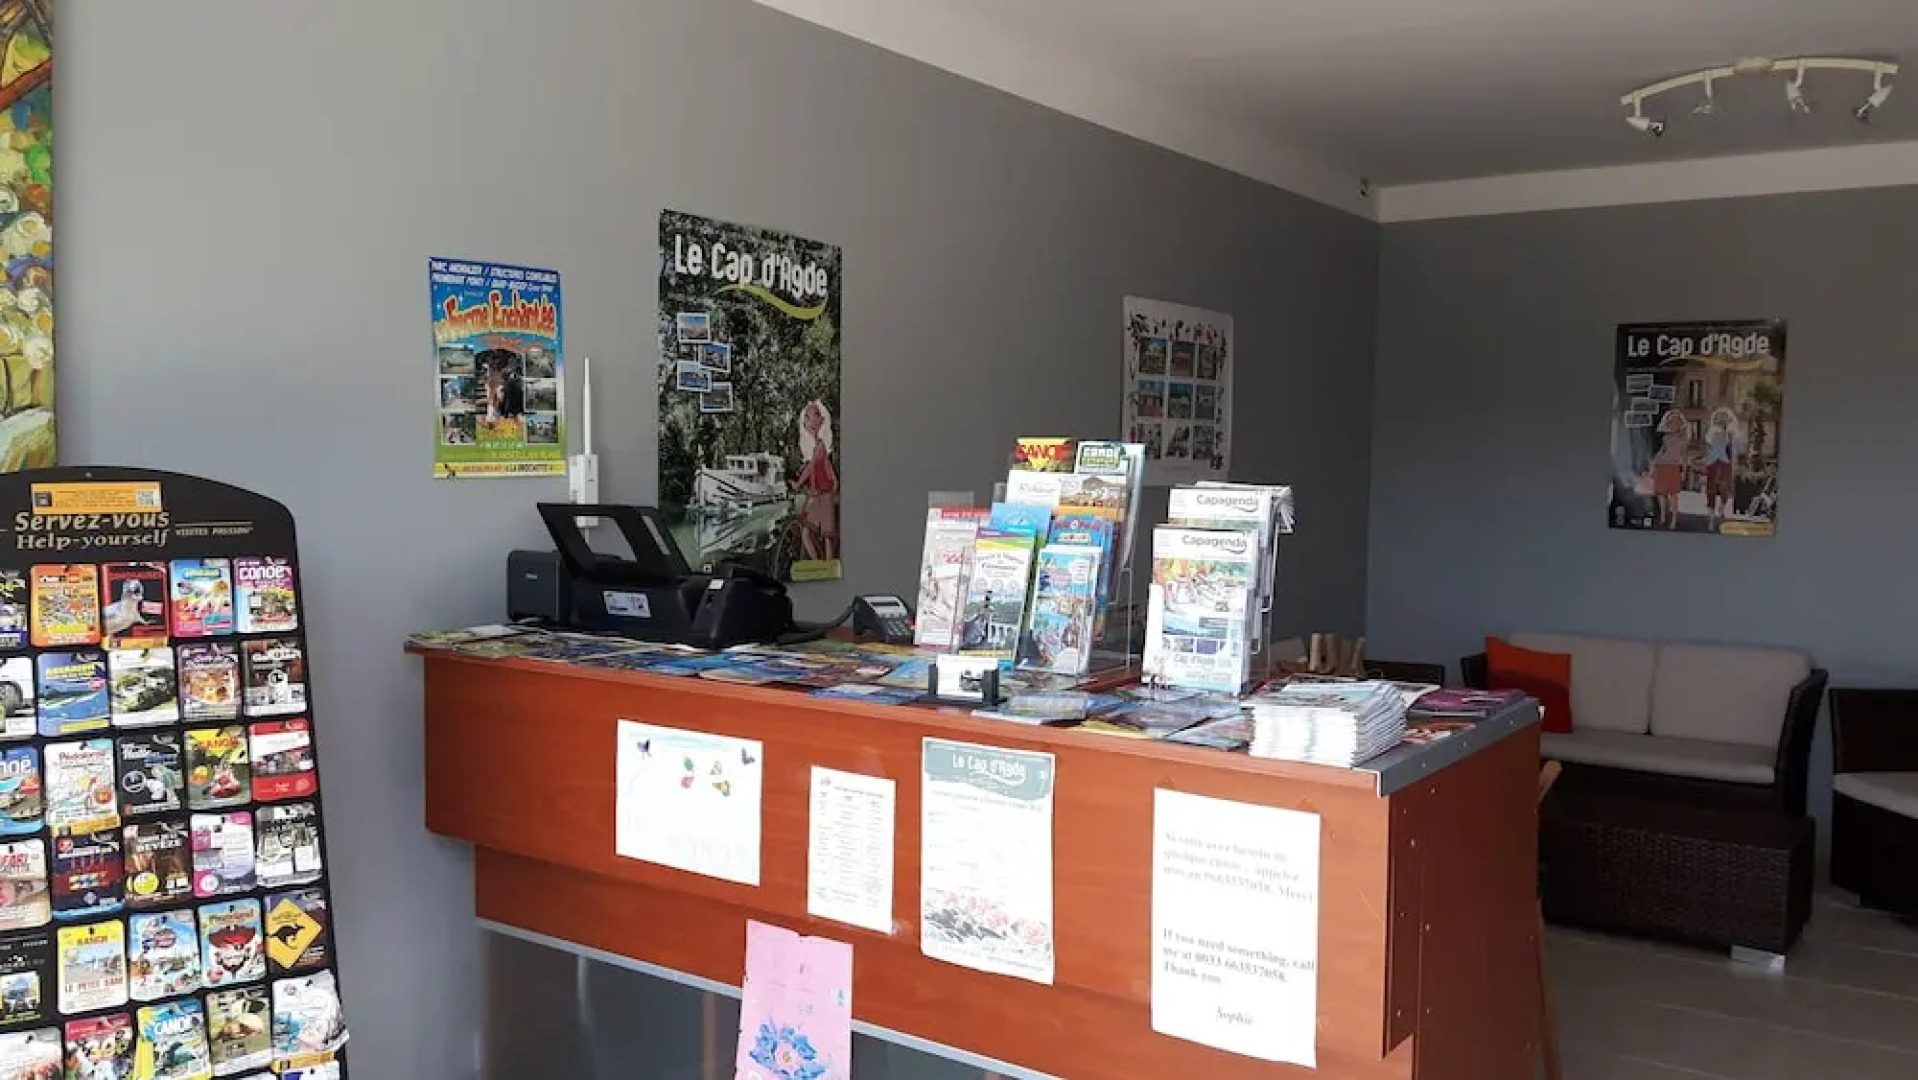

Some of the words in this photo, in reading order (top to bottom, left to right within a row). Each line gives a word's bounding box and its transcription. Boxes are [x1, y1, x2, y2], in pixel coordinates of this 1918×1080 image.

[674, 233, 702, 275] Le
[711, 243, 752, 285] Cap
[761, 252, 828, 299] d'Agde
[1627, 335, 1650, 357] Le
[1656, 333, 1693, 358] Cap
[1700, 331, 1770, 359] d'Agde
[1195, 493, 1259, 507] Capagenda
[14, 510, 171, 532] Servez-vous
[16, 528, 170, 551] Help-yourself
[1180, 534, 1248, 548] Capagenda
[952, 752, 965, 769] Le
[967, 755, 988, 773] Cap
[1175, 931, 1195, 945] you
[1198, 936, 1225, 952] need
[1162, 946, 1178, 959] me
[1163, 960, 1199, 978] Thank
[1216, 1004, 1254, 1026] Sophie
